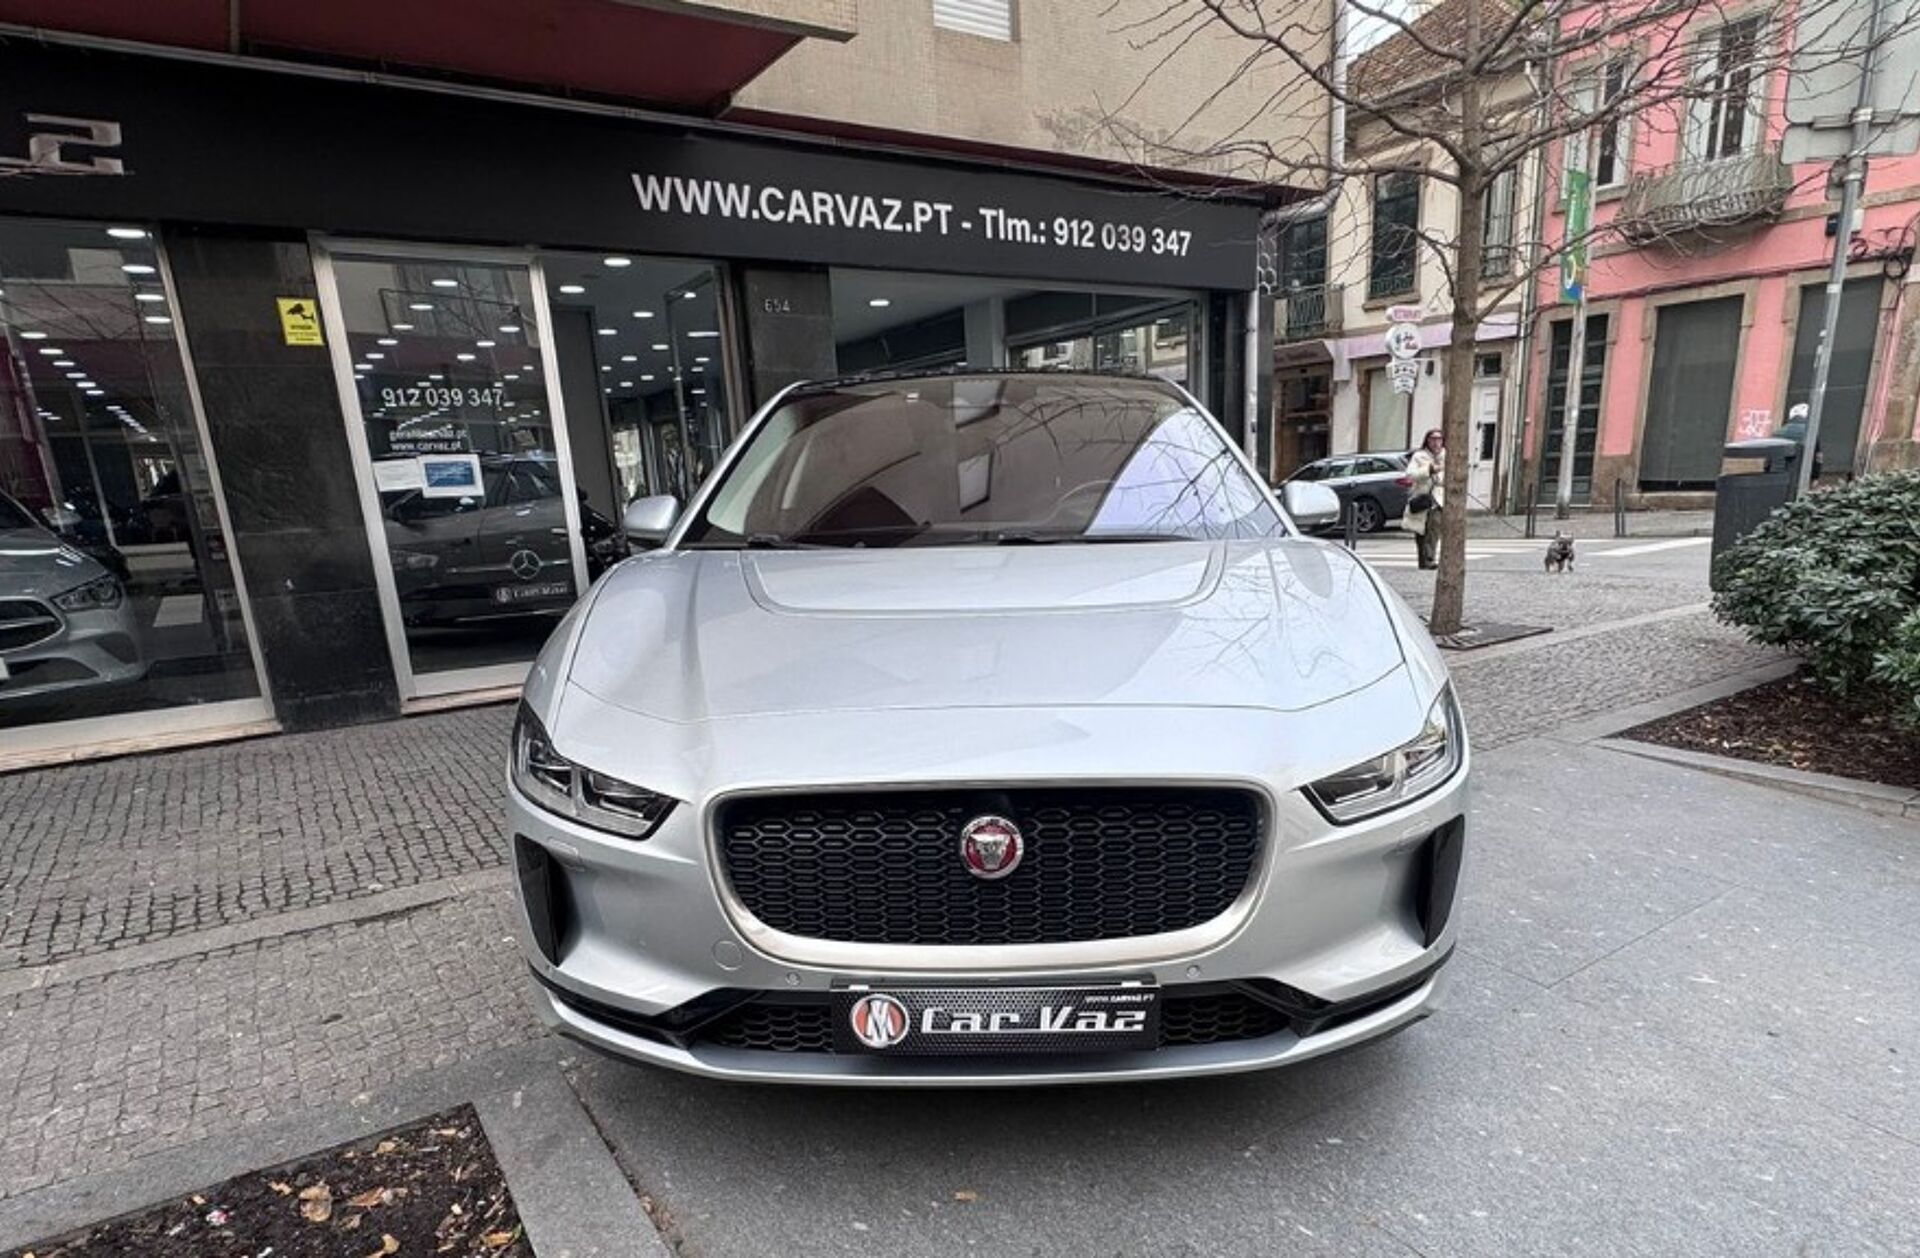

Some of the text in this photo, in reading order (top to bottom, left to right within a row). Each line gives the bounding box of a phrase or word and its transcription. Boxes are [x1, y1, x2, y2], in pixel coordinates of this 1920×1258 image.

[631, 173, 952, 235] WWW.CARVAZ.PT
[978, 206, 1046, 245] Tlm.:
[1053, 217, 1095, 248] 912
[1101, 222, 1147, 253] 039
[1151, 228, 1192, 257] 347
[381, 387, 503, 407] 912 039 347
[920, 1006, 1020, 1034] Car
[1038, 1005, 1147, 1032] Vaz
